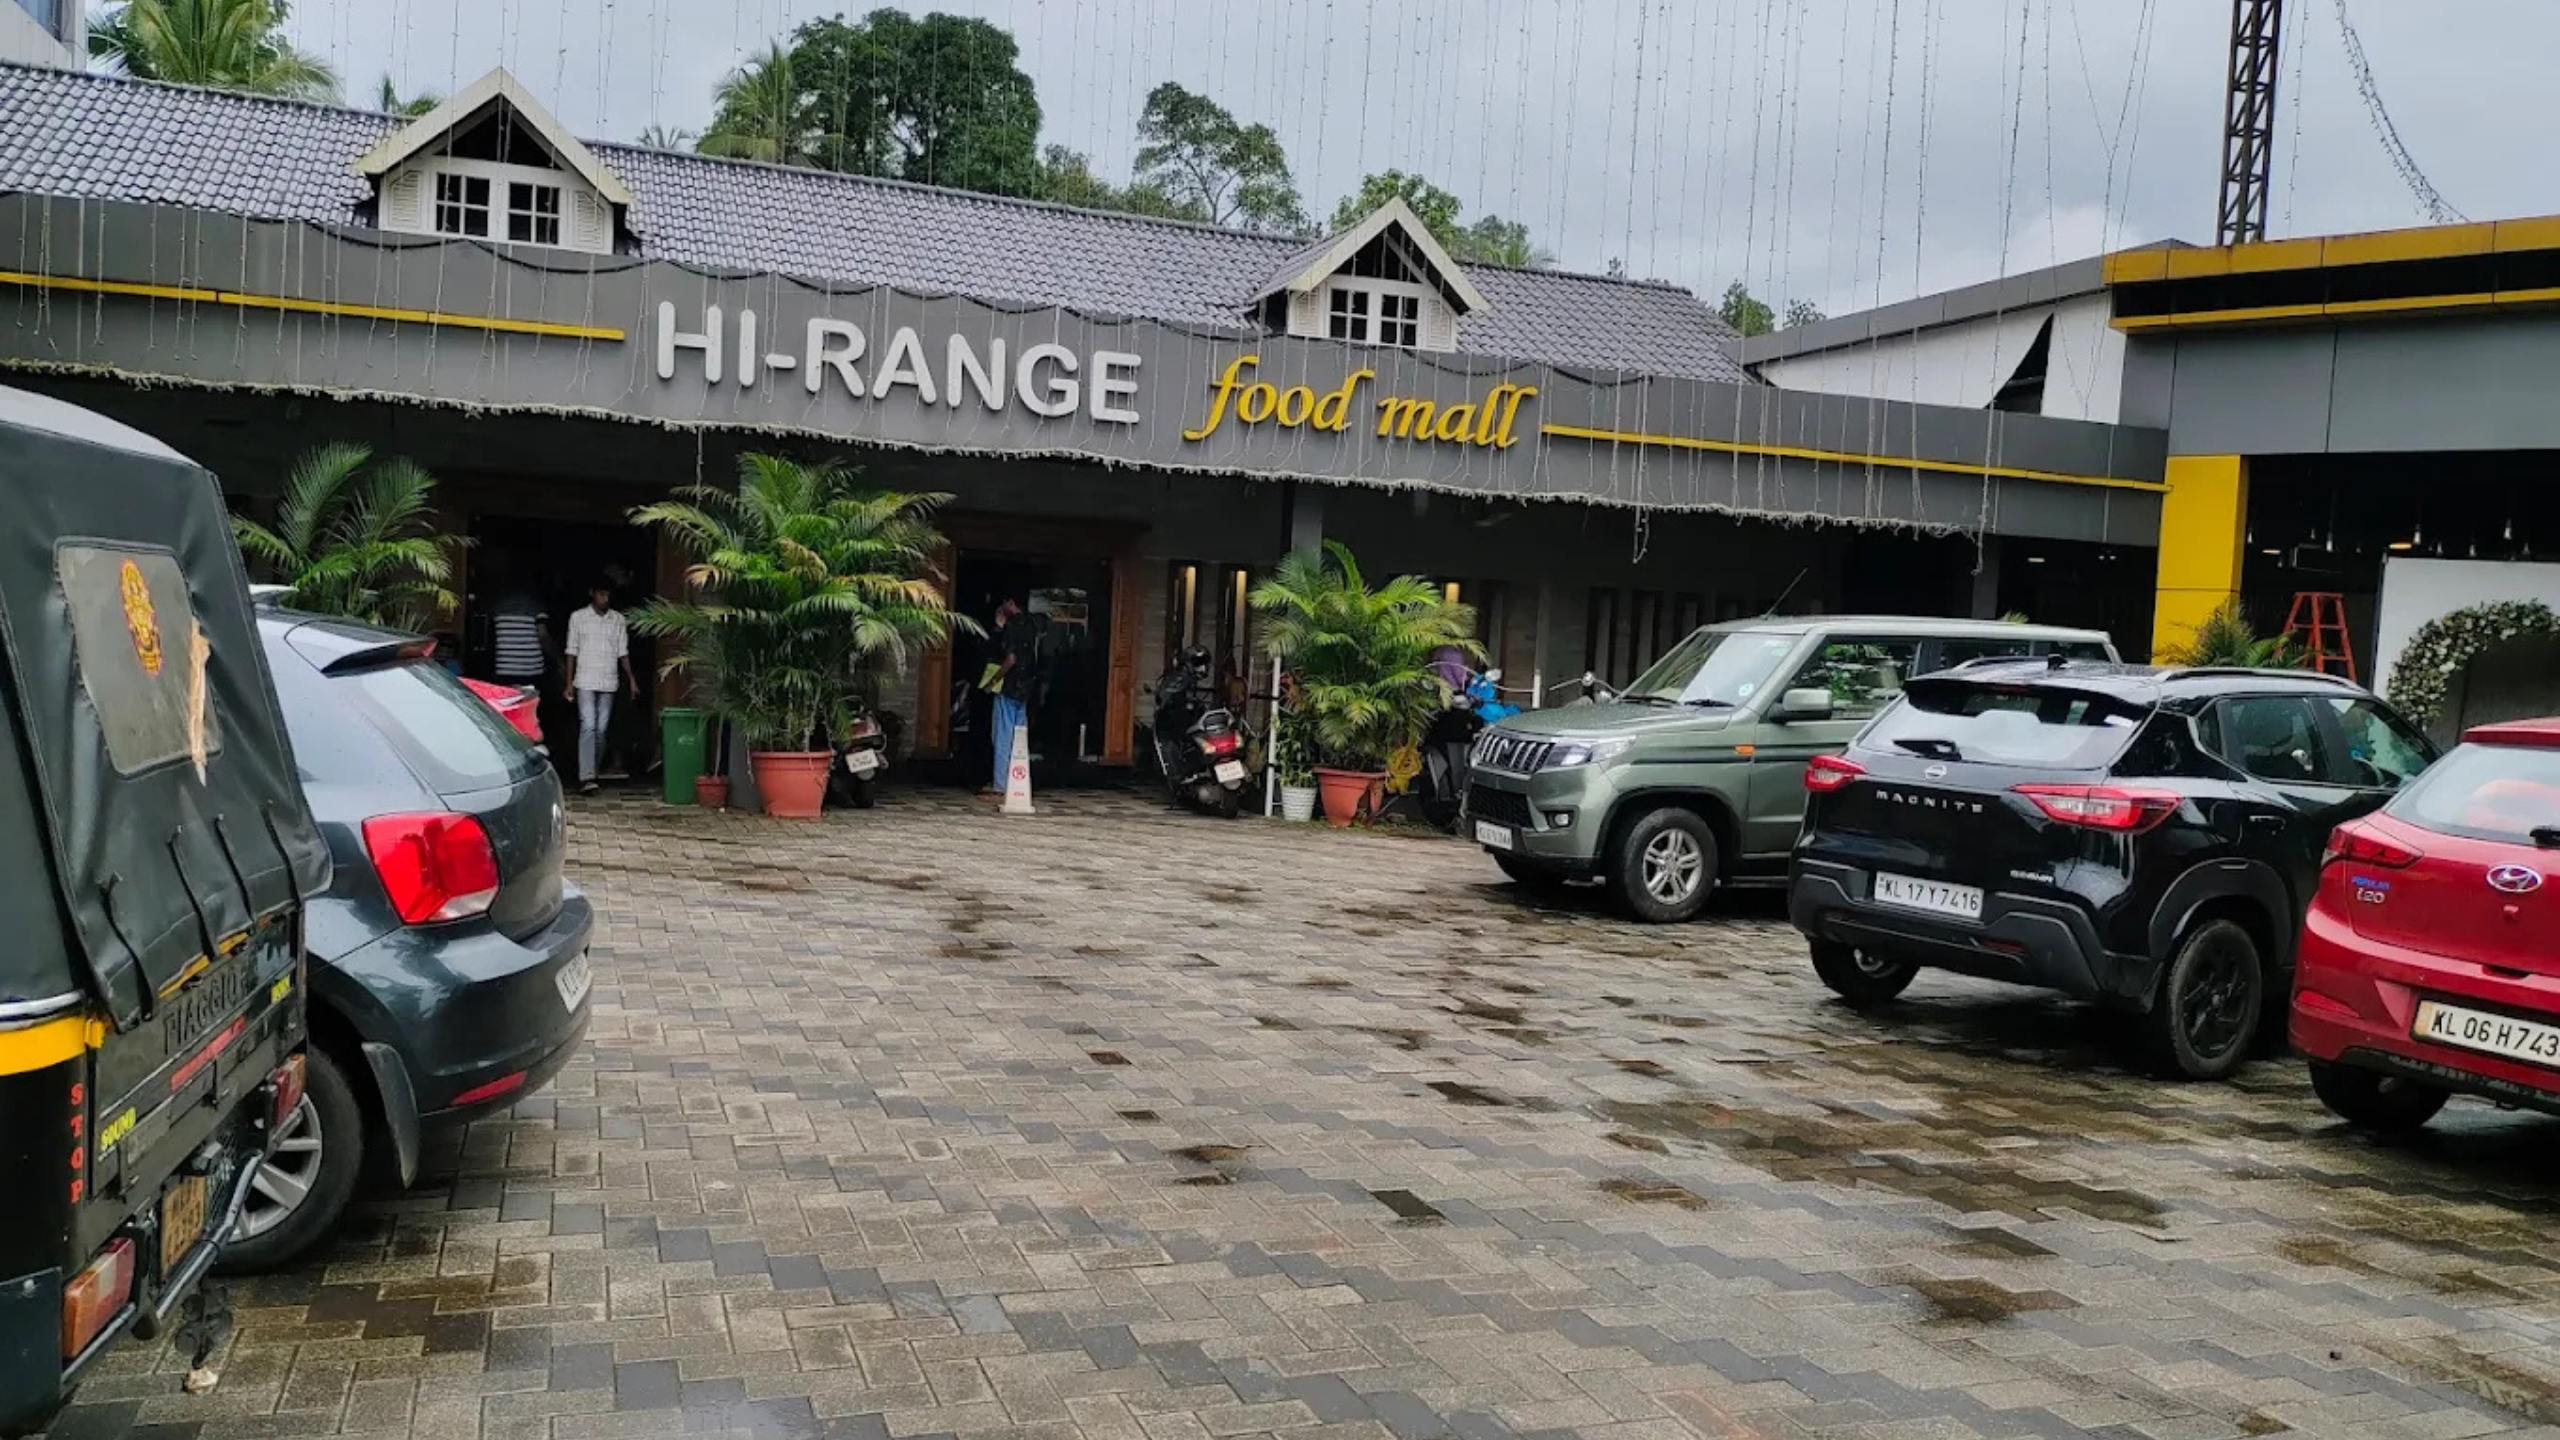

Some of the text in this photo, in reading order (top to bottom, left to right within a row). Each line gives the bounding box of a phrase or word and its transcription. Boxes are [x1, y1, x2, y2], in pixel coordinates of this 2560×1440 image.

[657, 301, 1142, 424] HI-RANGE
[1183, 355, 1538, 449] food mall
[1876, 789, 1983, 813] MAGNITE
[1885, 879, 1979, 911] KL 17 Y 7416
[2356, 887, 2386, 904] i20
[2431, 1010, 2560, 1057] KL 06 H 743
